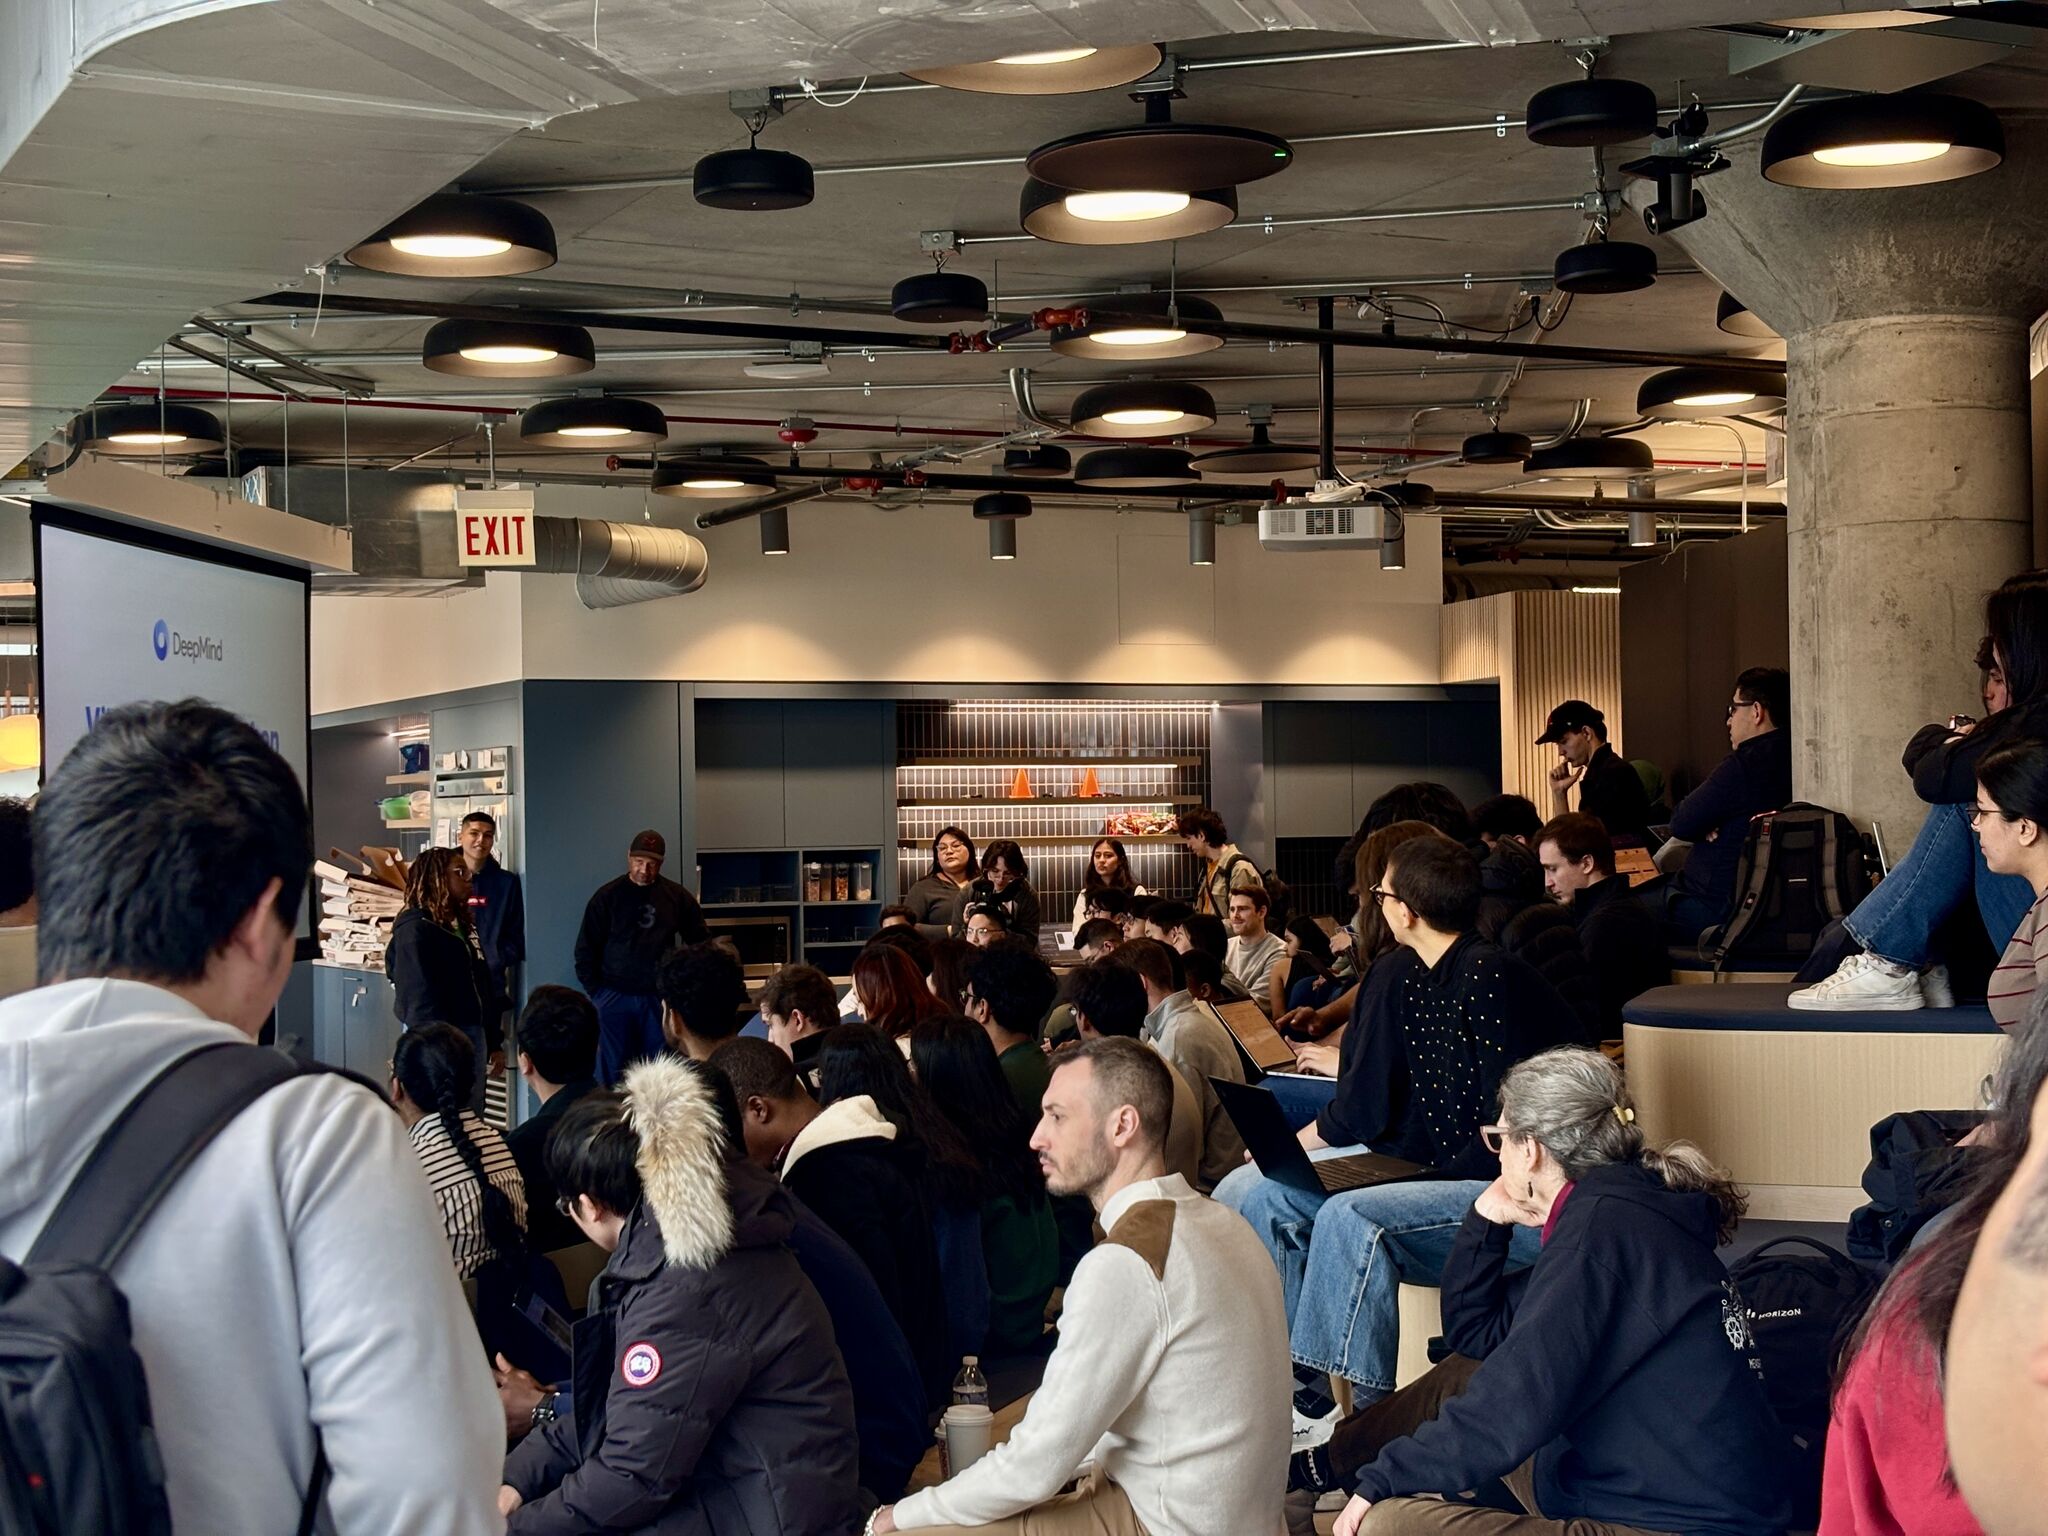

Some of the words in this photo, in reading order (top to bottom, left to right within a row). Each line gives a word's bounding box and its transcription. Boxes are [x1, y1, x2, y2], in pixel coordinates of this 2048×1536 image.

[465, 516, 526, 556] EXIT
[173, 631, 223, 664] DeepMind
[1758, 1308, 1802, 1320] HORIZON
